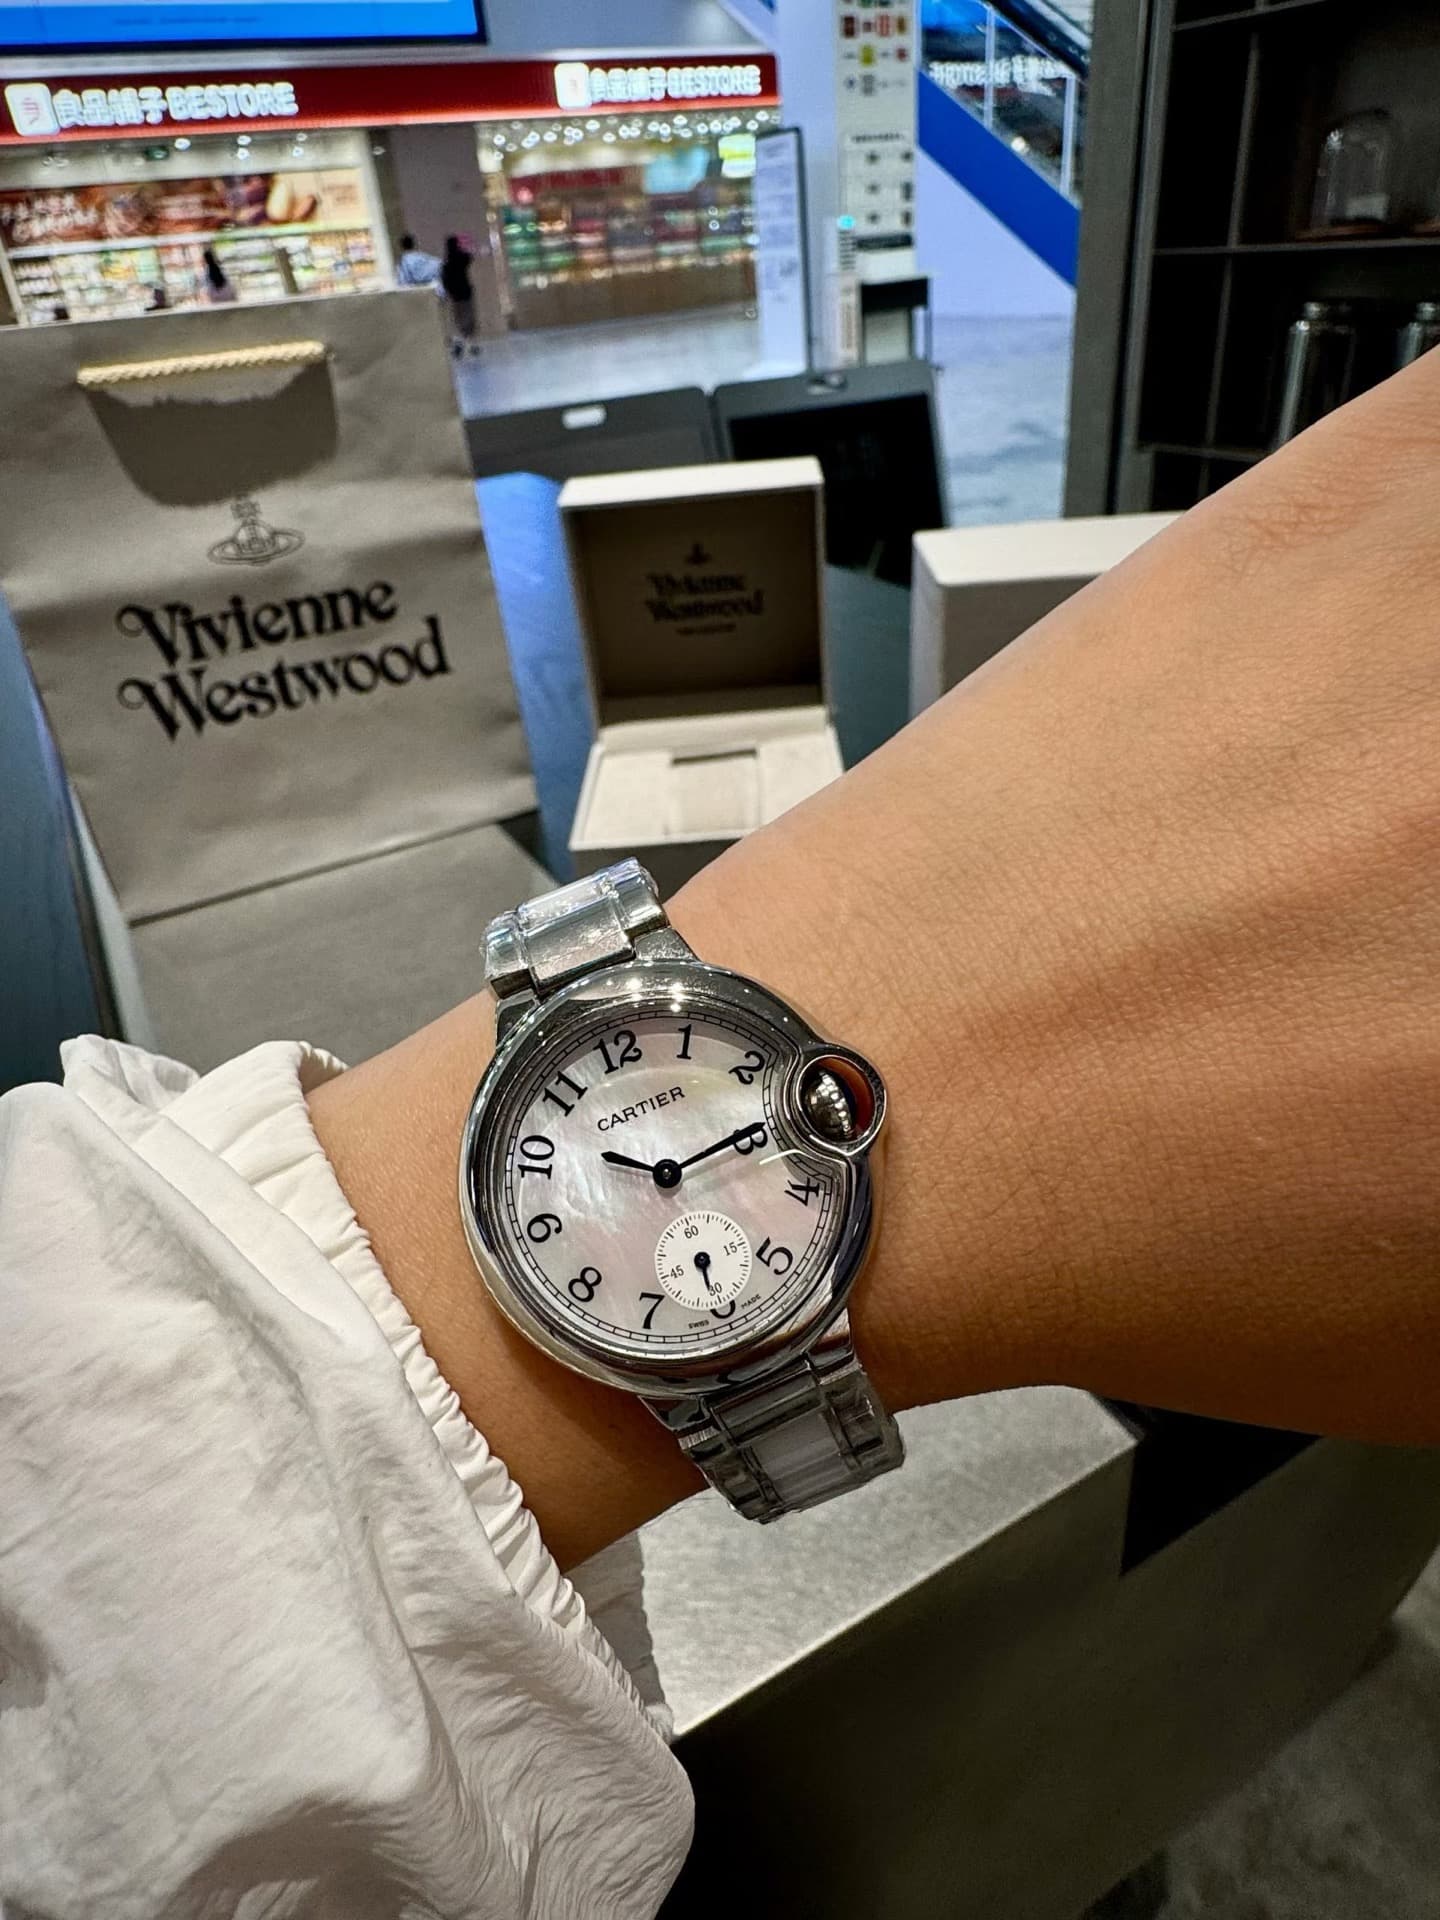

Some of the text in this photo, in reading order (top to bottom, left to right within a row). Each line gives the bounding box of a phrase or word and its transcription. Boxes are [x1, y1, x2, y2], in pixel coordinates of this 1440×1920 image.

[667, 65, 762, 98] BESTORE
[53, 82, 298, 128] 良品铺子 BESTORE
[115, 580, 398, 668] Vivienne
[117, 614, 452, 743] Westwood
[594, 1029, 643, 1075] 12
[676, 1024, 693, 1060] 1
[728, 1050, 766, 1086] 2
[541, 1070, 588, 1118] 11
[596, 1085, 686, 1132] CARTIER
[518, 1134, 556, 1180] 10
[784, 1176, 820, 1206] 4
[525, 1212, 563, 1244] 9
[684, 1225, 699, 1239] 60
[723, 1241, 738, 1256] 15
[755, 1236, 793, 1275] 5
[567, 1266, 603, 1302] 8
[670, 1265, 684, 1279] 45
[638, 1291, 665, 1330] 7
[741, 1294, 761, 1309] MADE
